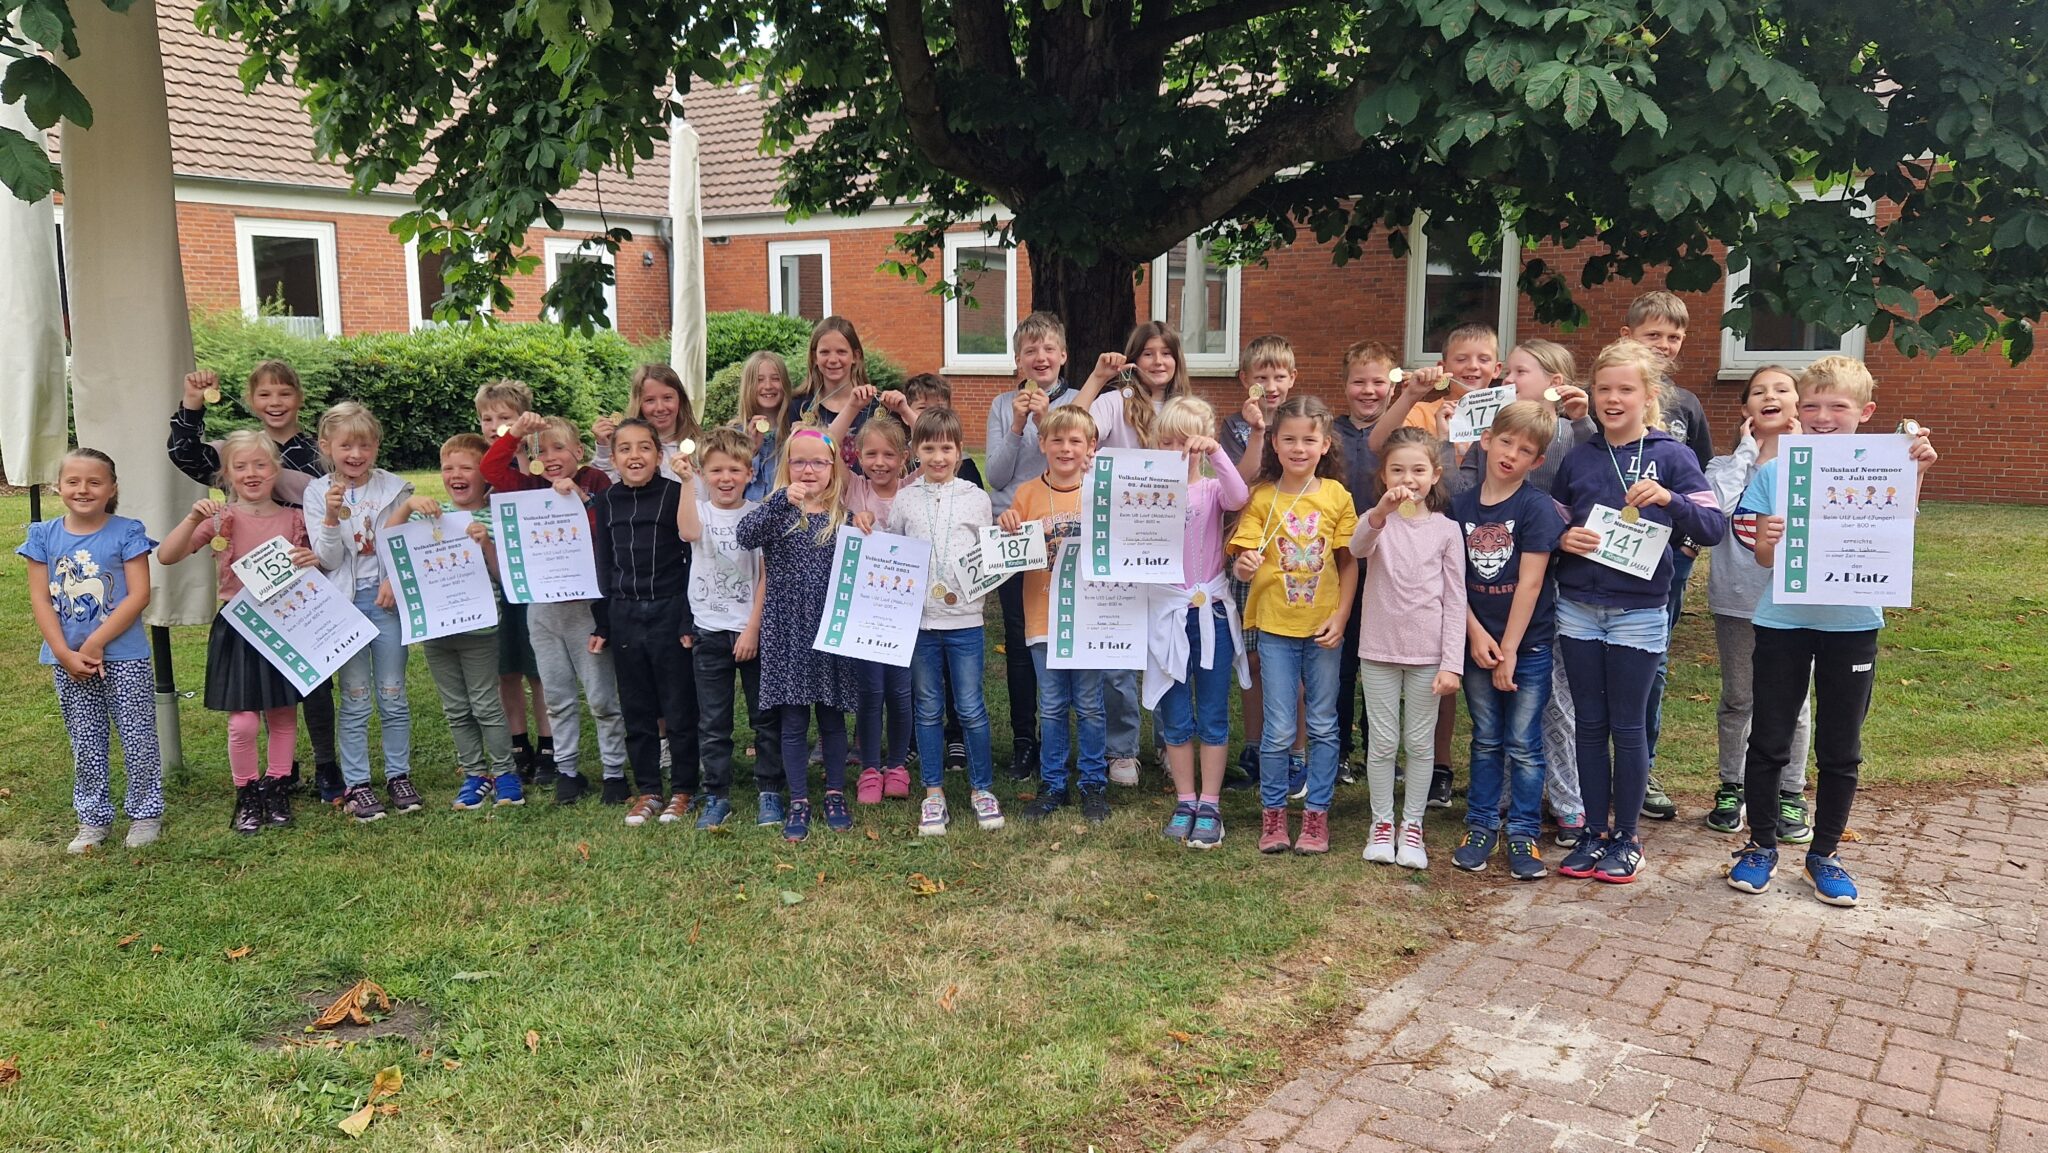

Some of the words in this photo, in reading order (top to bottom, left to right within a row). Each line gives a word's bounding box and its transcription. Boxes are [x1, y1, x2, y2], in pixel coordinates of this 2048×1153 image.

[1465, 403, 1502, 427] 177
[1096, 459, 1112, 574] Urkunde
[1789, 451, 1810, 590] Urkunde
[997, 538, 1031, 559] 187
[1605, 529, 1643, 558] 141
[256, 552, 292, 580] 153
[1122, 557, 1134, 566] 2.
[1136, 557, 1170, 566] Platz
[1824, 571, 1840, 582] 2.
[1844, 572, 1889, 583] Platz
[828, 539, 860, 646] Urkunde
[1060, 545, 1079, 657] Urkunde
[234, 603, 317, 683] Urkunde
[1099, 641, 1132, 650] Platz
